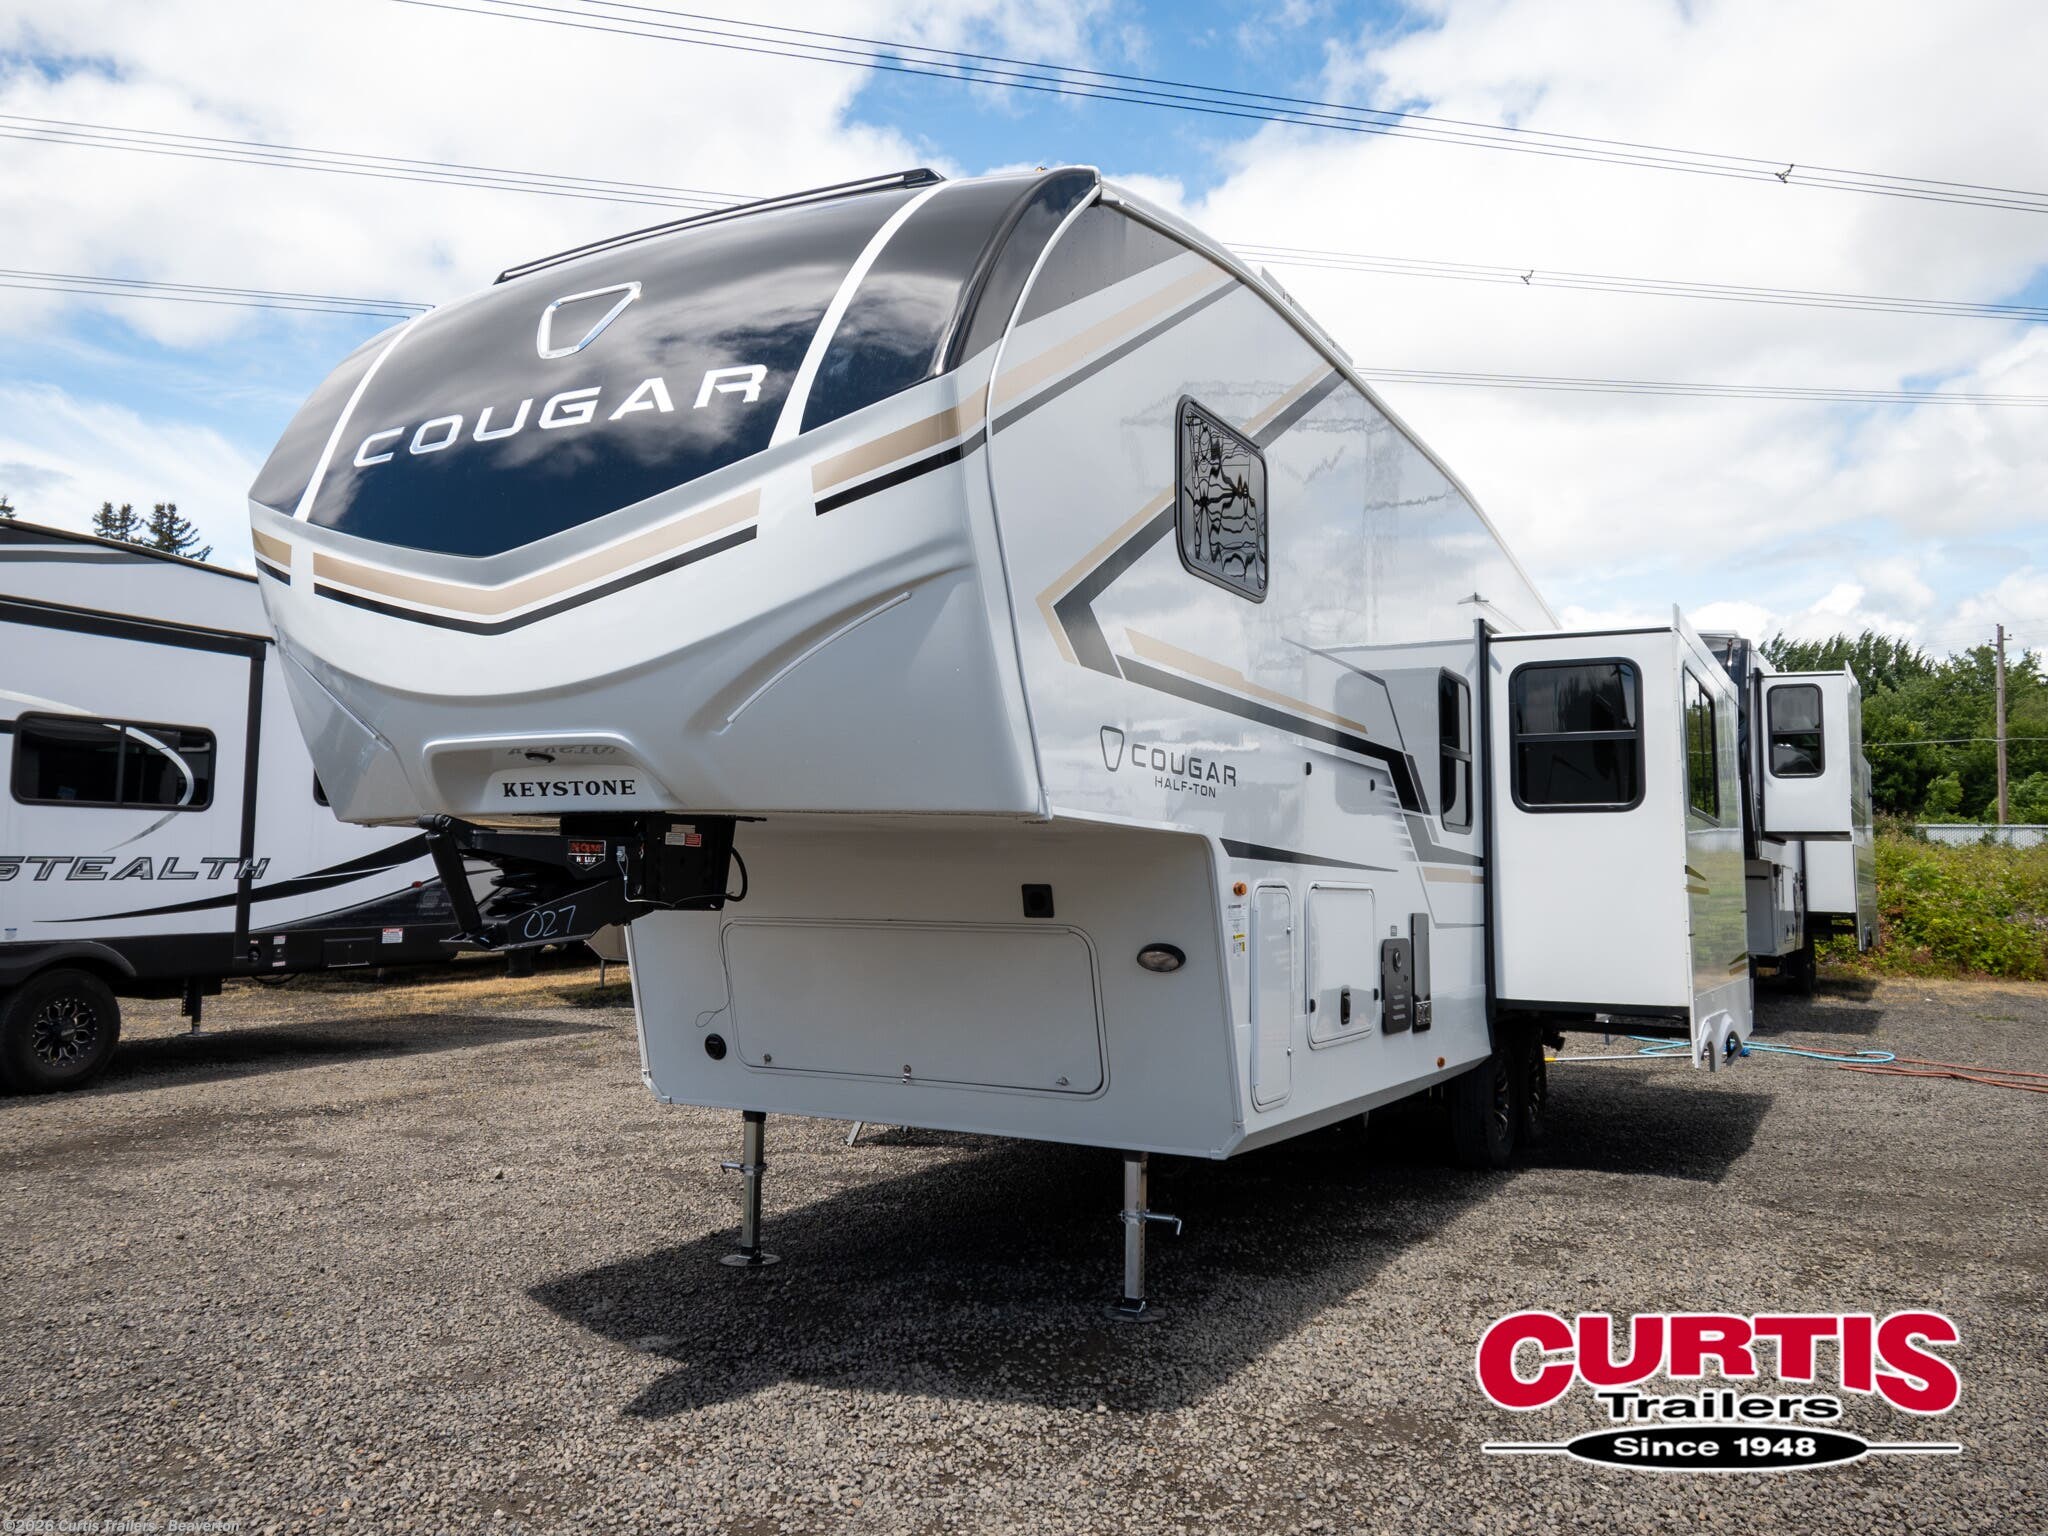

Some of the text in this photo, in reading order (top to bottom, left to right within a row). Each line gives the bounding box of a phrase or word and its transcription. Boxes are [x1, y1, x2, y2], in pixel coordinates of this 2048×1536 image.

[353, 363, 768, 468] COUGAR
[1131, 742, 1238, 788] COUGAR
[503, 778, 637, 798] KEYSTONE
[1154, 774, 1217, 799] HALF-TON
[0, 856, 272, 882] STEALTH
[523, 904, 578, 940] 027
